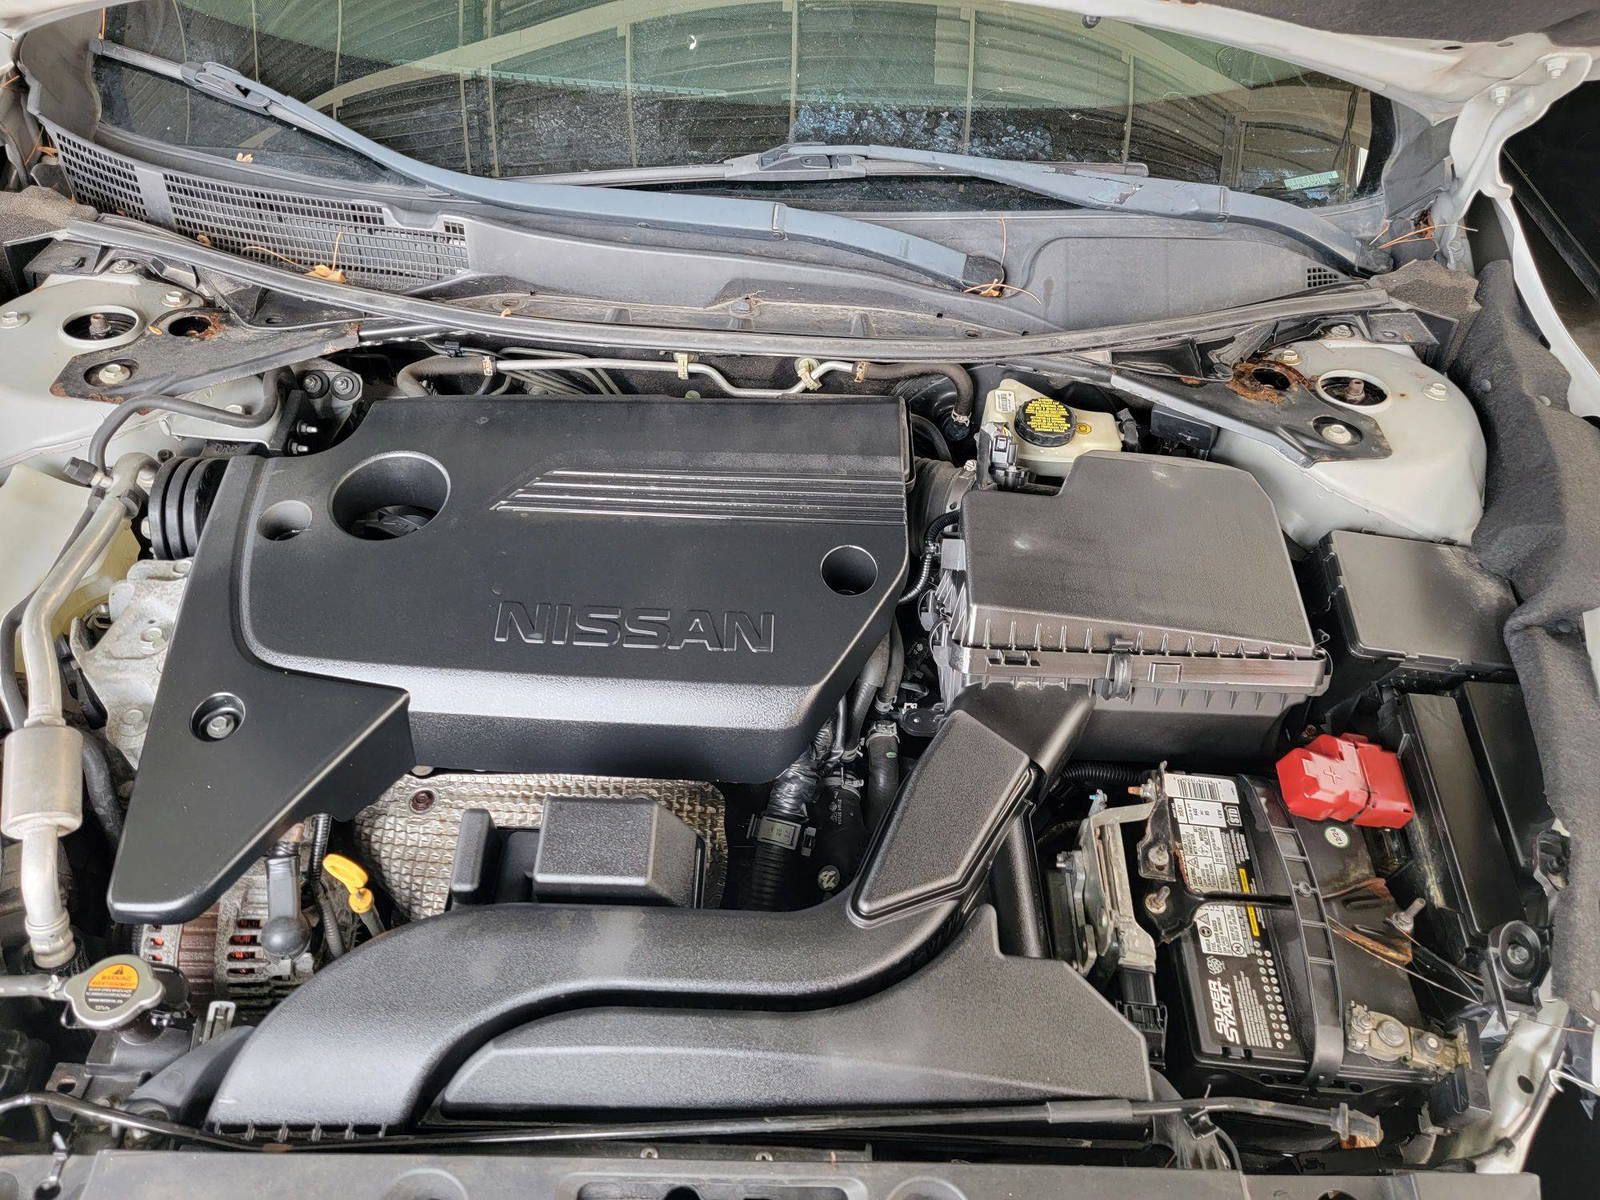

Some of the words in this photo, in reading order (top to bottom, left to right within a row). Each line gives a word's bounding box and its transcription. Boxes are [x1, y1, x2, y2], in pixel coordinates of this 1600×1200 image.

[495, 601, 775, 654] NISSAN
[1228, 808, 1240, 823] STD
[1208, 980, 1226, 1034] SUPER
[1214, 980, 1240, 1044] START
